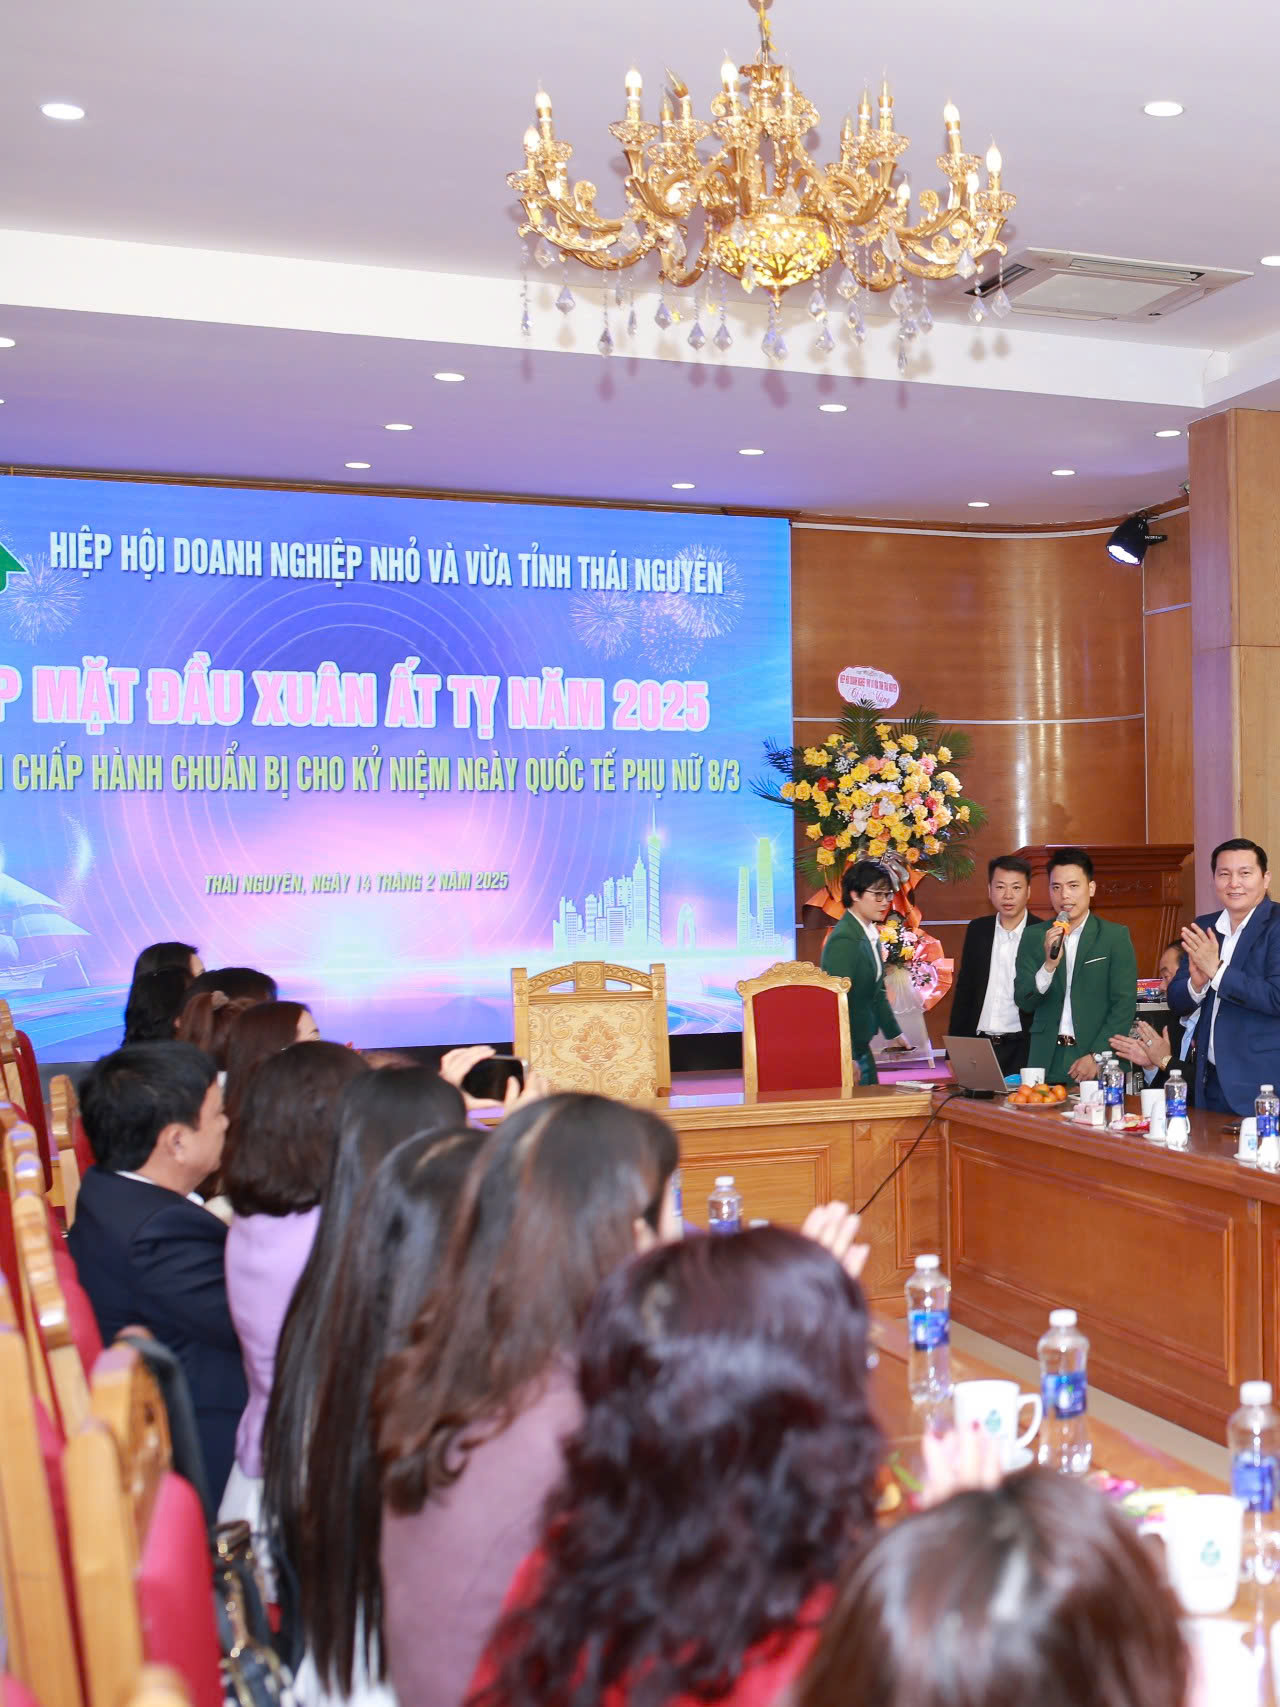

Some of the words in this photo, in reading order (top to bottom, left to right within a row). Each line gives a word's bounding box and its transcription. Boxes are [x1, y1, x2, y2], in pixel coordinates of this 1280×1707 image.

[50, 524, 112, 578] HIỆP
[121, 527, 165, 580] HỘI
[173, 537, 263, 577] DOANH
[270, 536, 363, 588] NGHIỆP
[370, 536, 421, 583] NHỎ
[428, 542, 459, 584] VÀ
[465, 544, 513, 586] VỪA
[518, 542, 571, 589] TỈNH
[578, 549, 629, 591] THÁI
[635, 554, 724, 594] NGUYÊN
[32, 655, 140, 736] MẶT
[146, 651, 244, 727] ĐẦU
[252, 660, 378, 727] XUÂN
[384, 656, 442, 729] ẤT
[447, 673, 501, 740] TỴ
[508, 666, 605, 730] NĂM
[613, 679, 710, 731] 2025
[12, 741, 84, 791] CHẤP
[92, 746, 164, 791] HÀNH
[171, 741, 257, 791] CHUẨN
[265, 755, 289, 799] BỊ
[296, 756, 345, 791] CHO
[352, 744, 383, 791] KỶ
[390, 749, 450, 799] NIỆM
[457, 750, 519, 792] NGÀY
[525, 745, 585, 796] QUỐC
[590, 747, 617, 791] TẾ
[622, 758, 665, 799] PHỤ
[672, 752, 704, 792] NỮ
[708, 759, 741, 792] 8/3
[204, 872, 239, 894] THÁI
[242, 872, 305, 895] NGUYÊN,
[311, 872, 351, 893] NGÀY
[376, 872, 423, 892] THÁNG
[425, 874, 435, 891] 2
[474, 872, 509, 890] 2025
